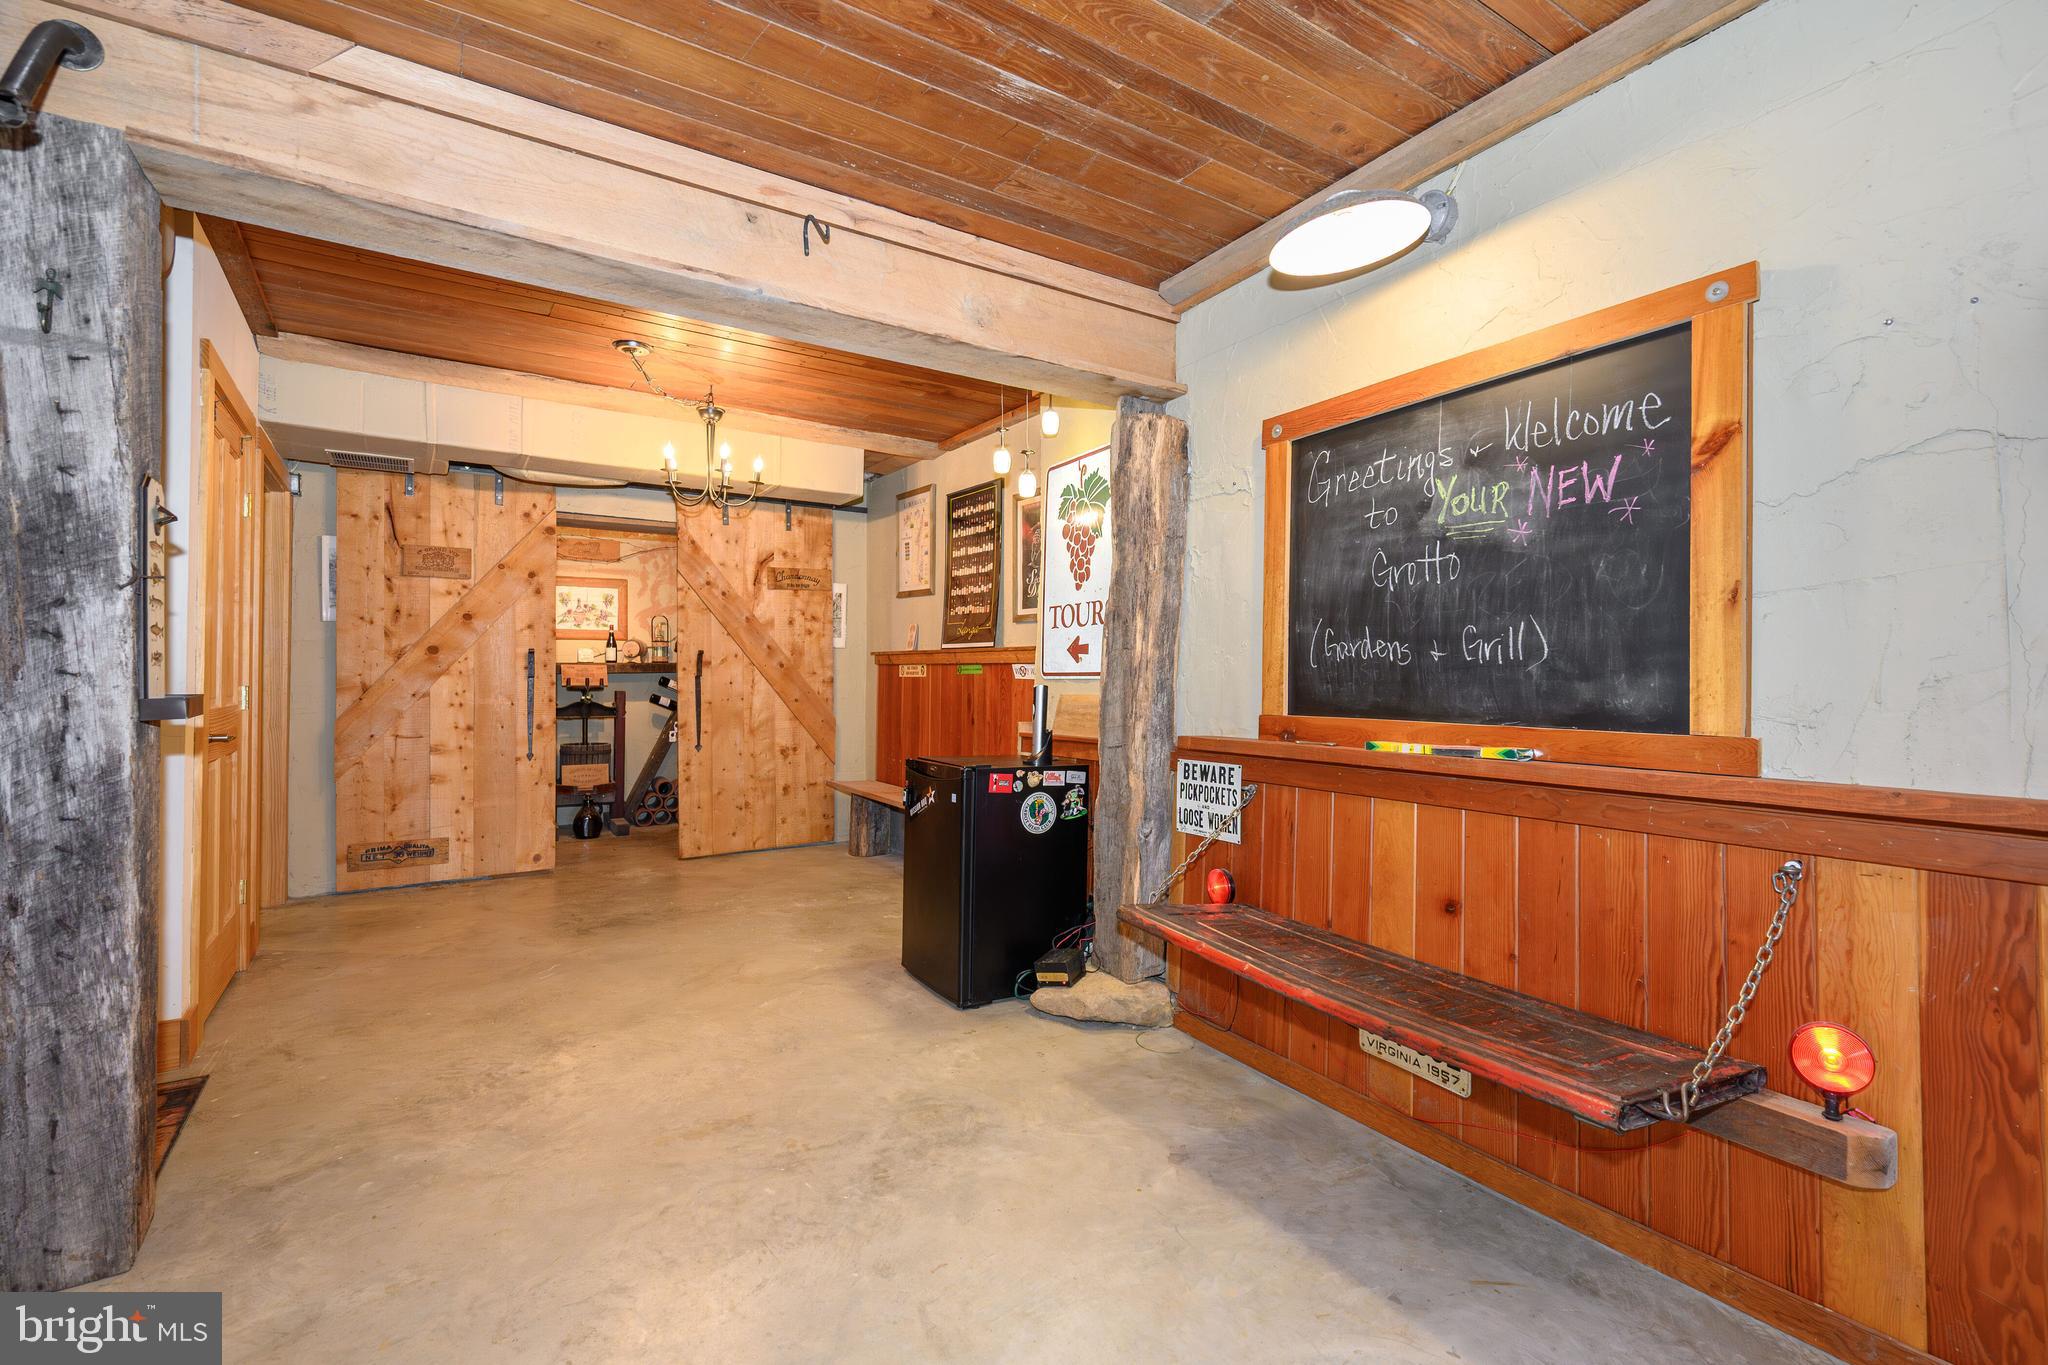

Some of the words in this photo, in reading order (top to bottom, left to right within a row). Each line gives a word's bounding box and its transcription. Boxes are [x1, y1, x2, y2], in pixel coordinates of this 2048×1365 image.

[1307, 446, 1454, 507] Greetings
[1505, 391, 1672, 452] Welcome
[1364, 495, 1399, 530] to
[1527, 454, 1622, 518] NEW
[775, 569, 821, 586] Chardonnay
[1371, 541, 1461, 592] Grotto
[1048, 600, 1105, 629] TOUR
[1183, 762, 1235, 785] BEWARE
[1179, 782, 1238, 807] PICKPOCKETS
[1178, 807, 1204, 828] LOOSE
[1366, 1036, 1421, 1070] VIRGINIA
[1426, 1063, 1461, 1085] 1957
